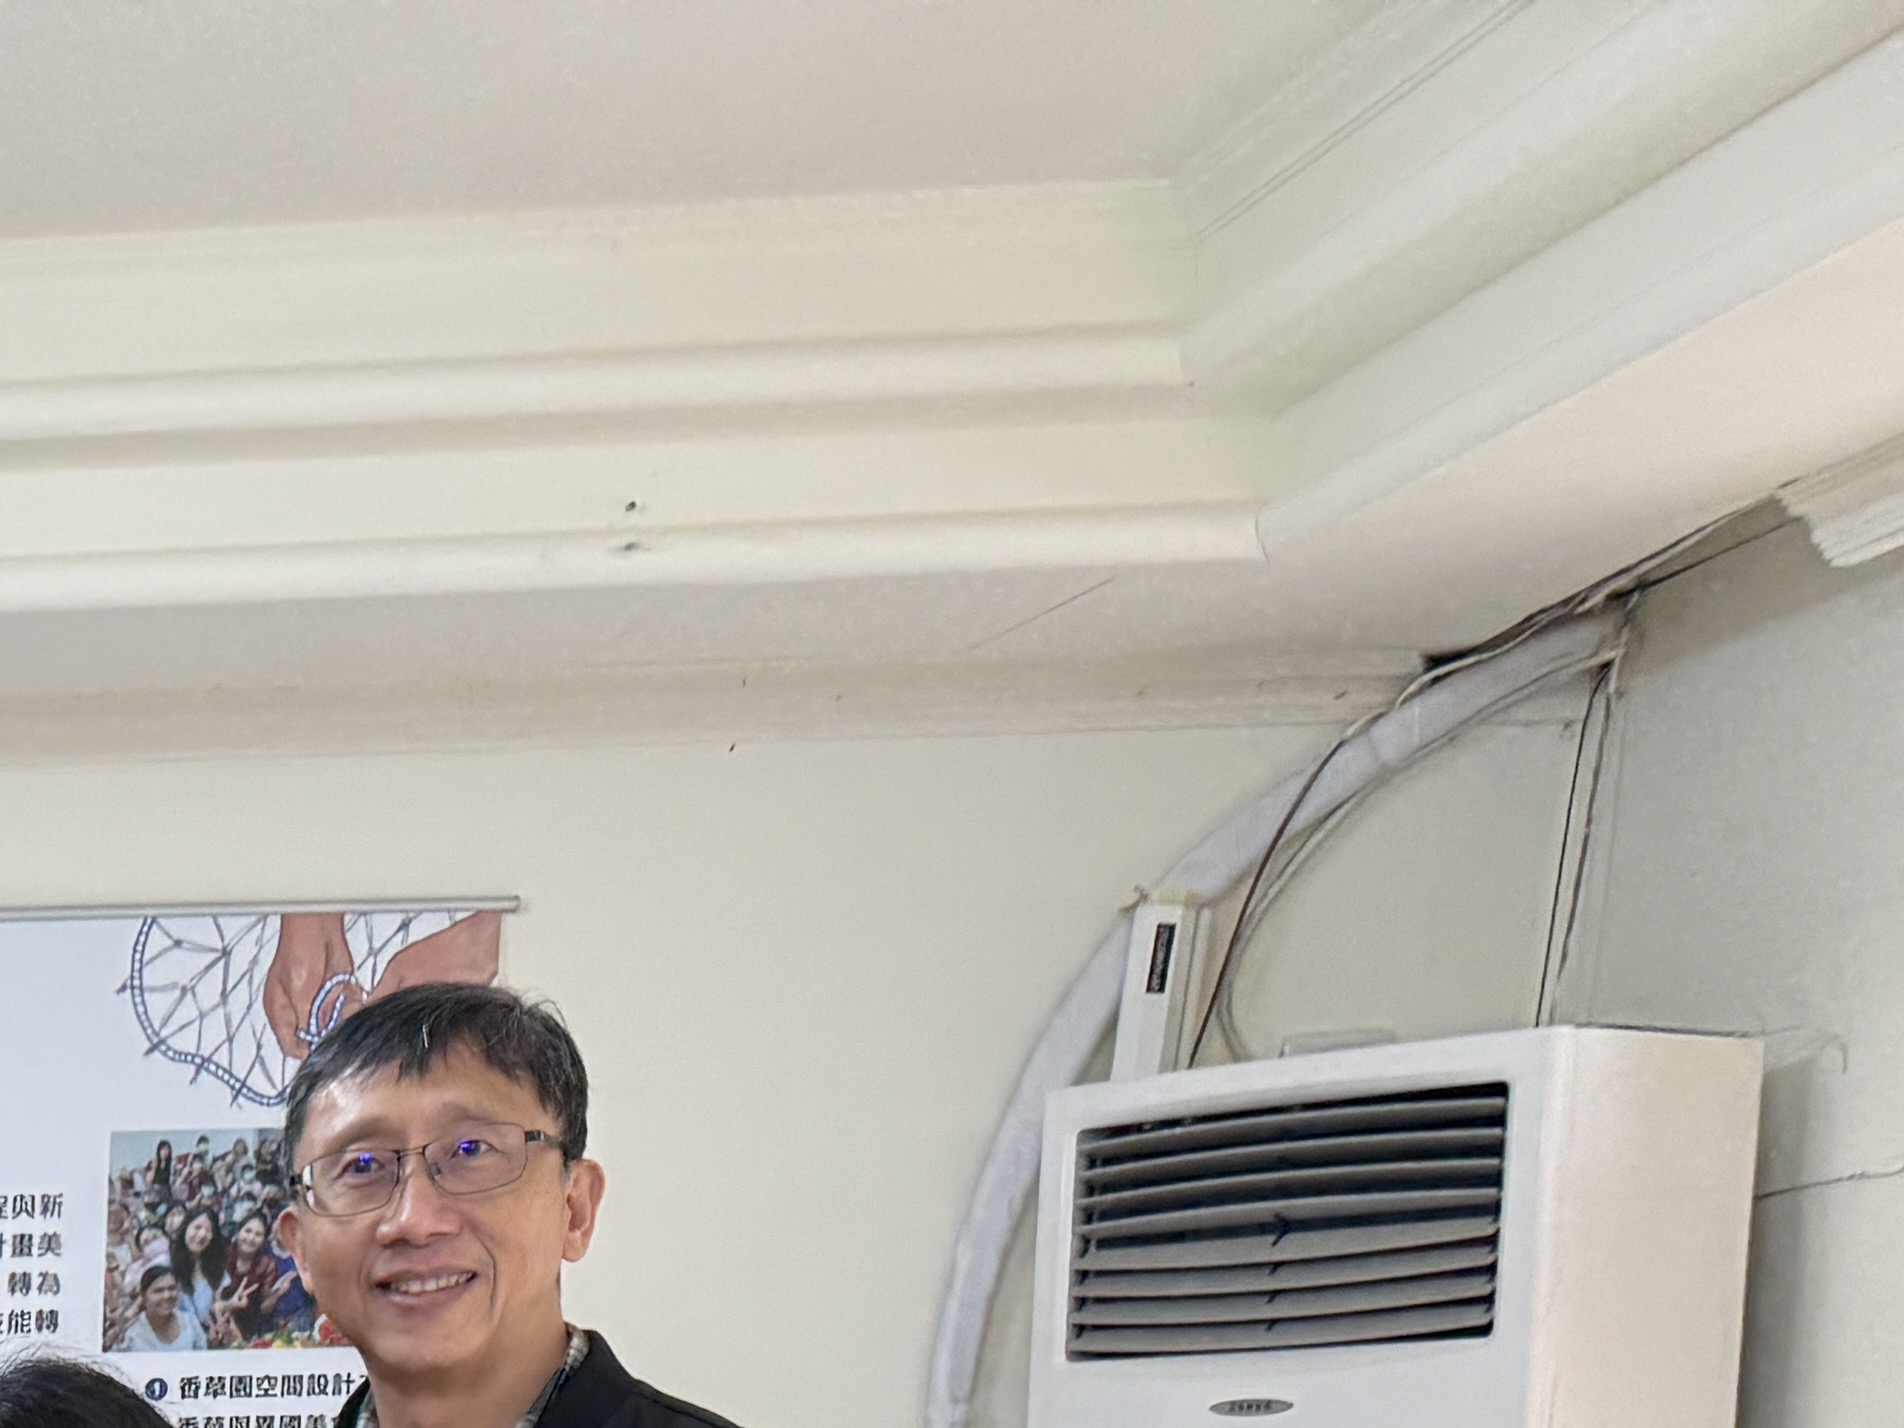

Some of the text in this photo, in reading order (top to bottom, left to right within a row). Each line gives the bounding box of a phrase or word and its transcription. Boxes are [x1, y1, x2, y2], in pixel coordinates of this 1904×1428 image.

[179, 1373, 368, 1400] 香草園空間設計
